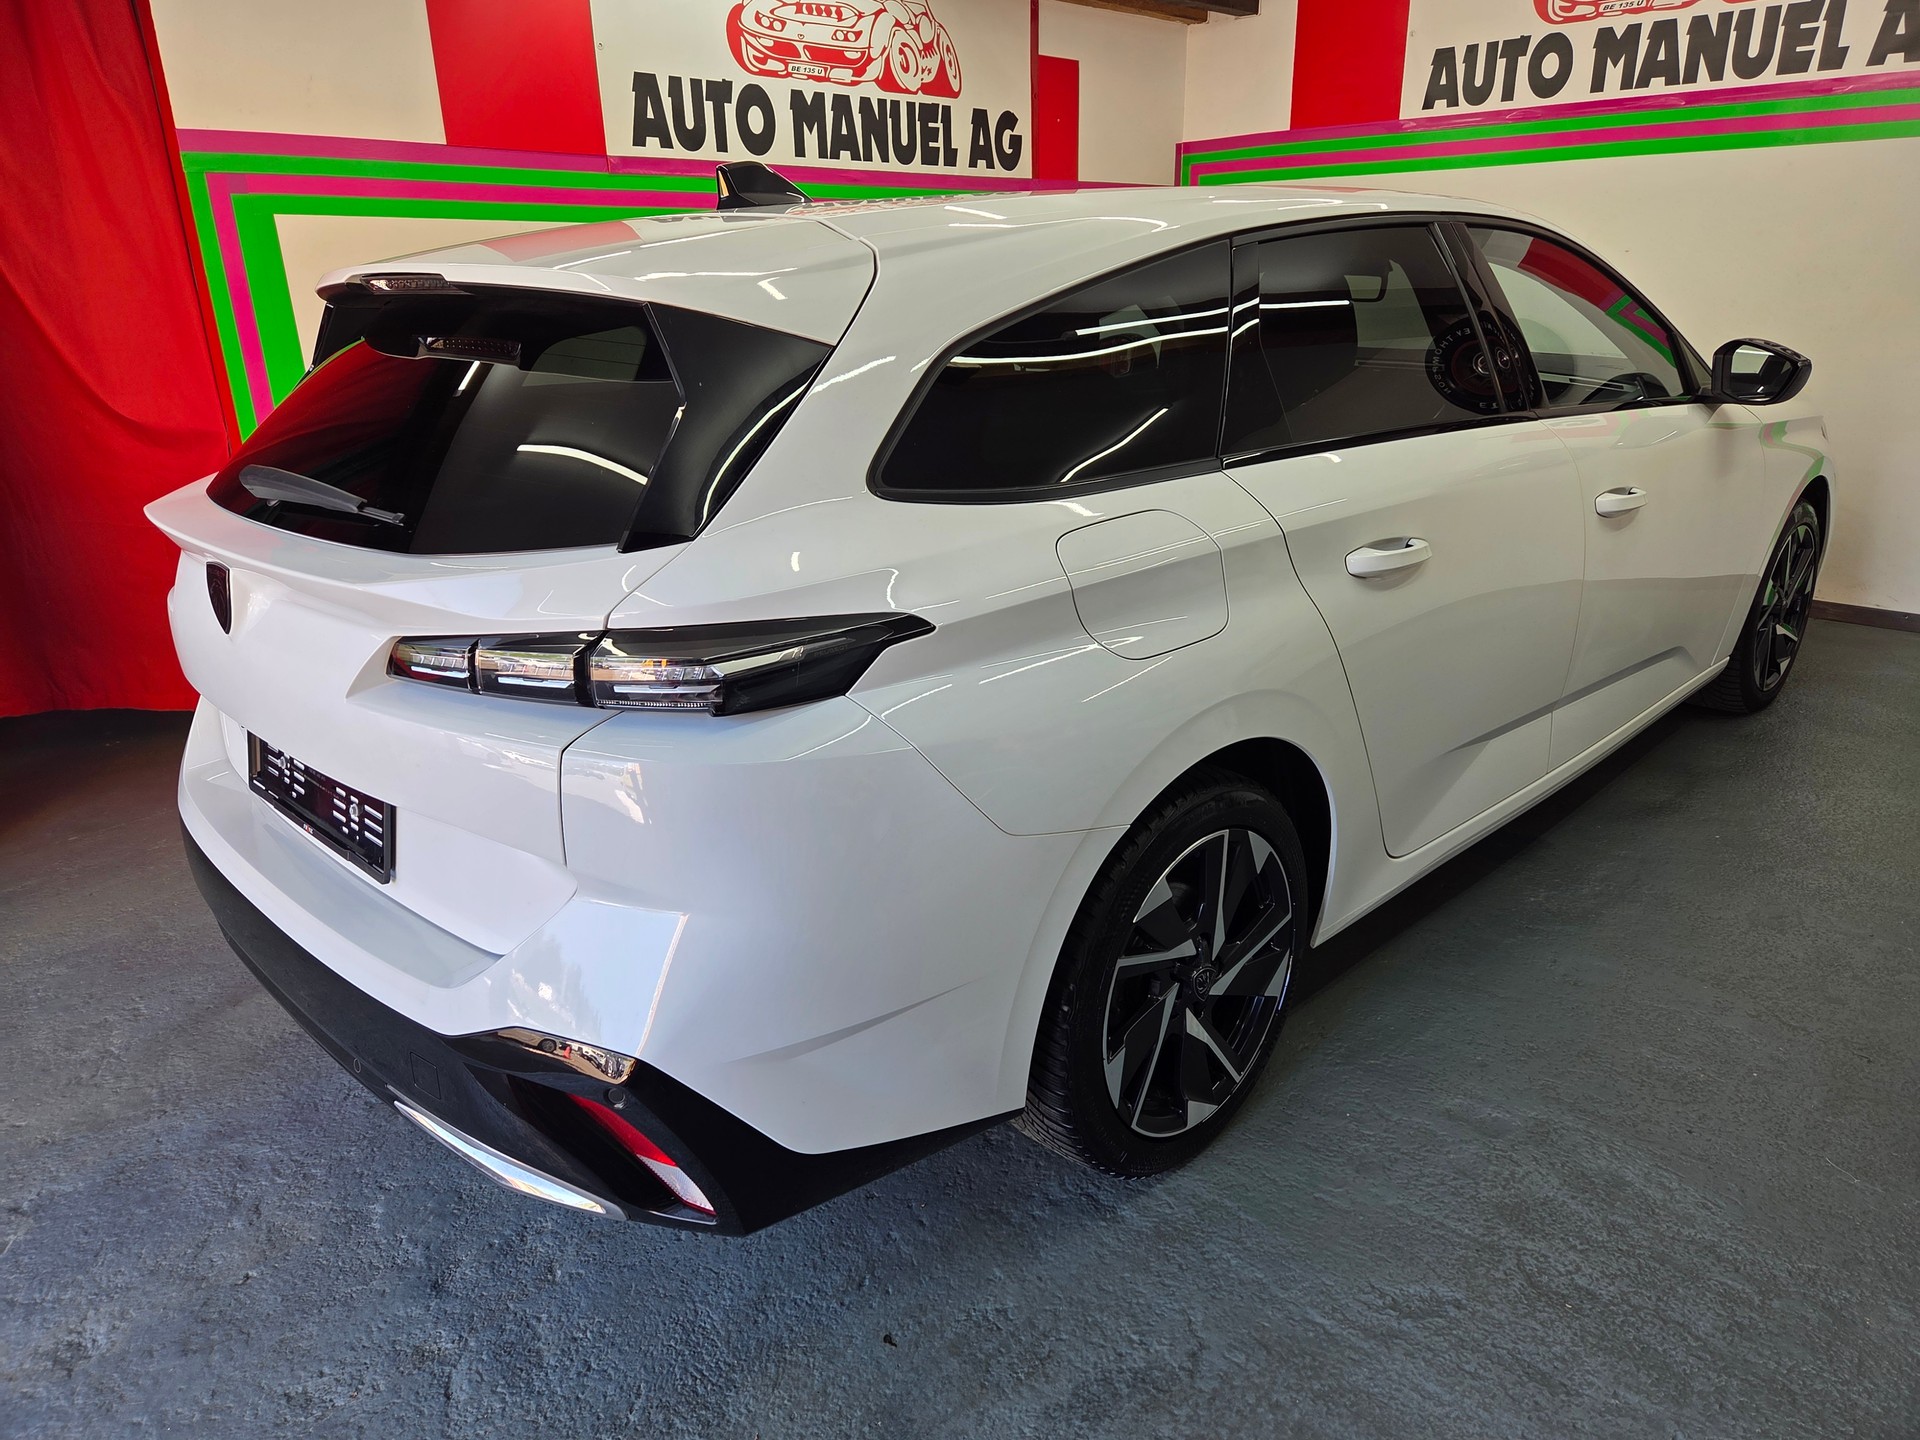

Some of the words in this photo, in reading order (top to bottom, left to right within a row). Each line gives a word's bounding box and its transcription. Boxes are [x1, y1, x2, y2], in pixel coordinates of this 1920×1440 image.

[1421, 32, 1574, 110] AUTO
[1589, 0, 1850, 94] MANUEL
[632, 71, 776, 156] AUTO
[790, 89, 958, 167] MANUEL
[968, 108, 1023, 171] AG
